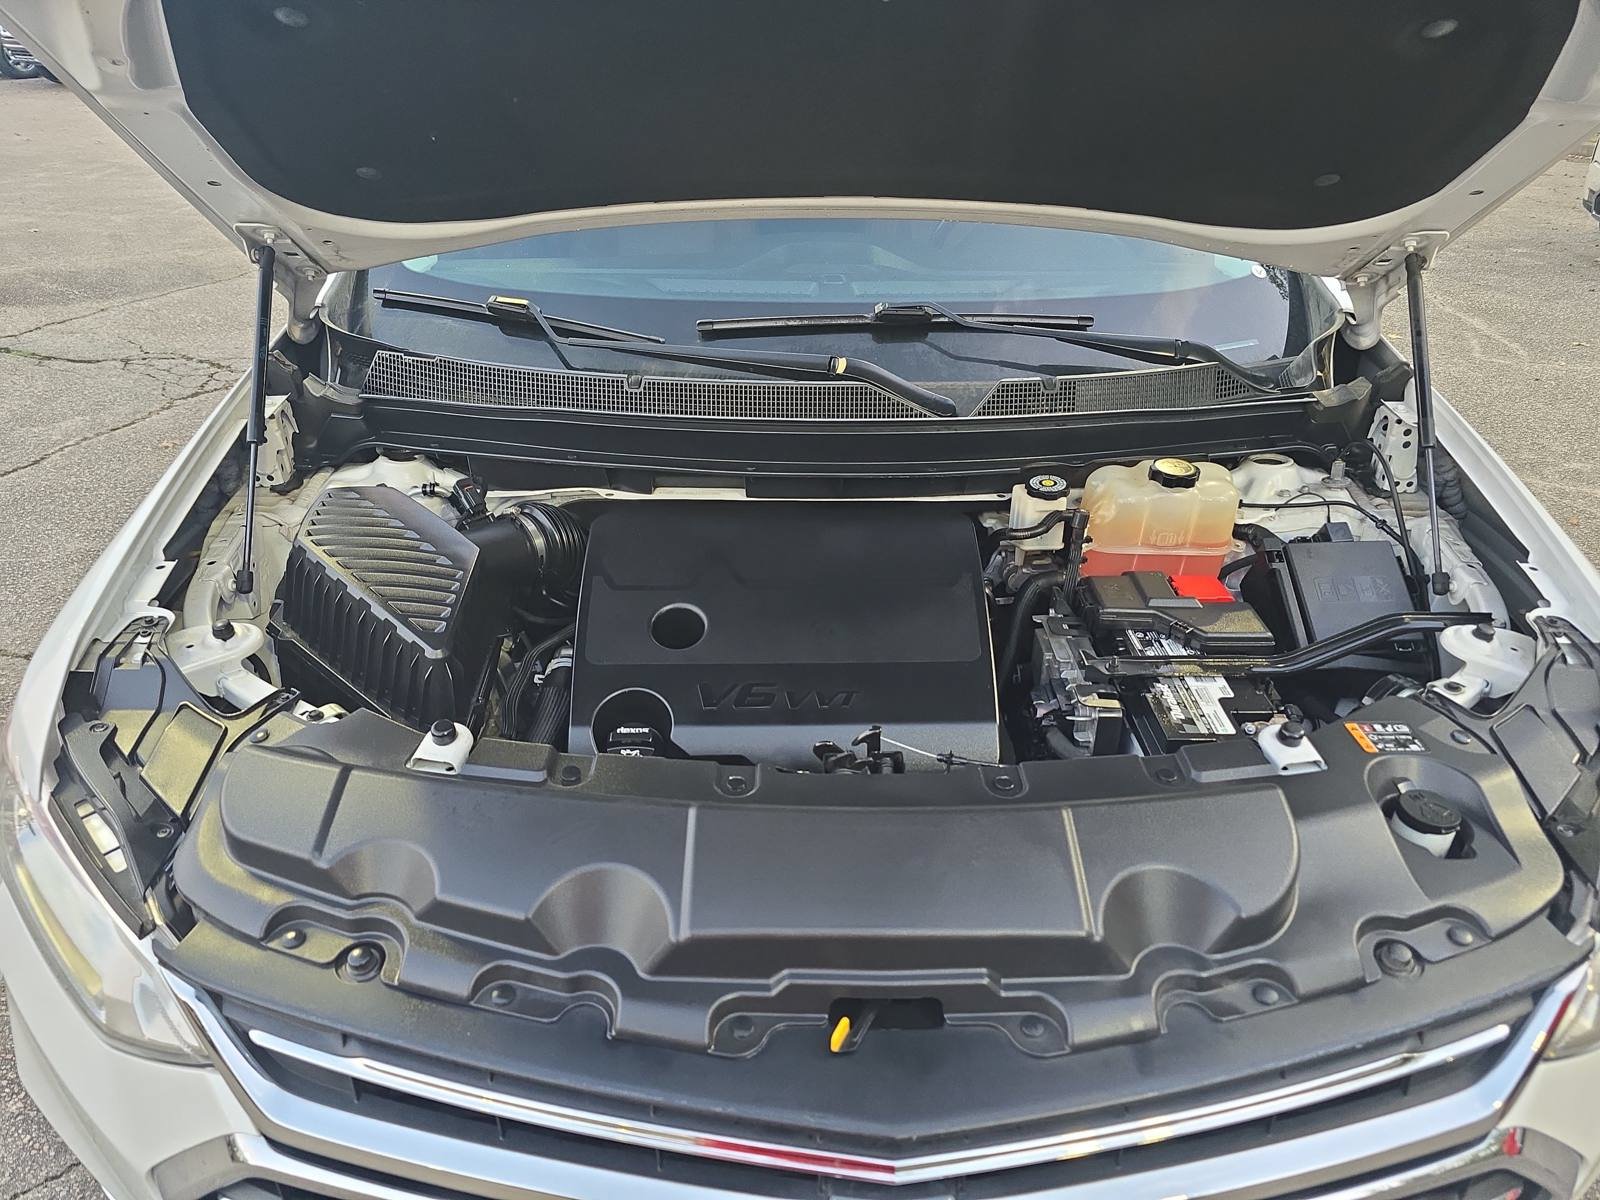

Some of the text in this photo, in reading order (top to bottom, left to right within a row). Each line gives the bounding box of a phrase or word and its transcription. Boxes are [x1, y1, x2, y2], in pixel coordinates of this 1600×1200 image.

[697, 680, 779, 711] V6
[1153, 683, 1186, 719] Duralast
[616, 726, 650, 734] dexos
